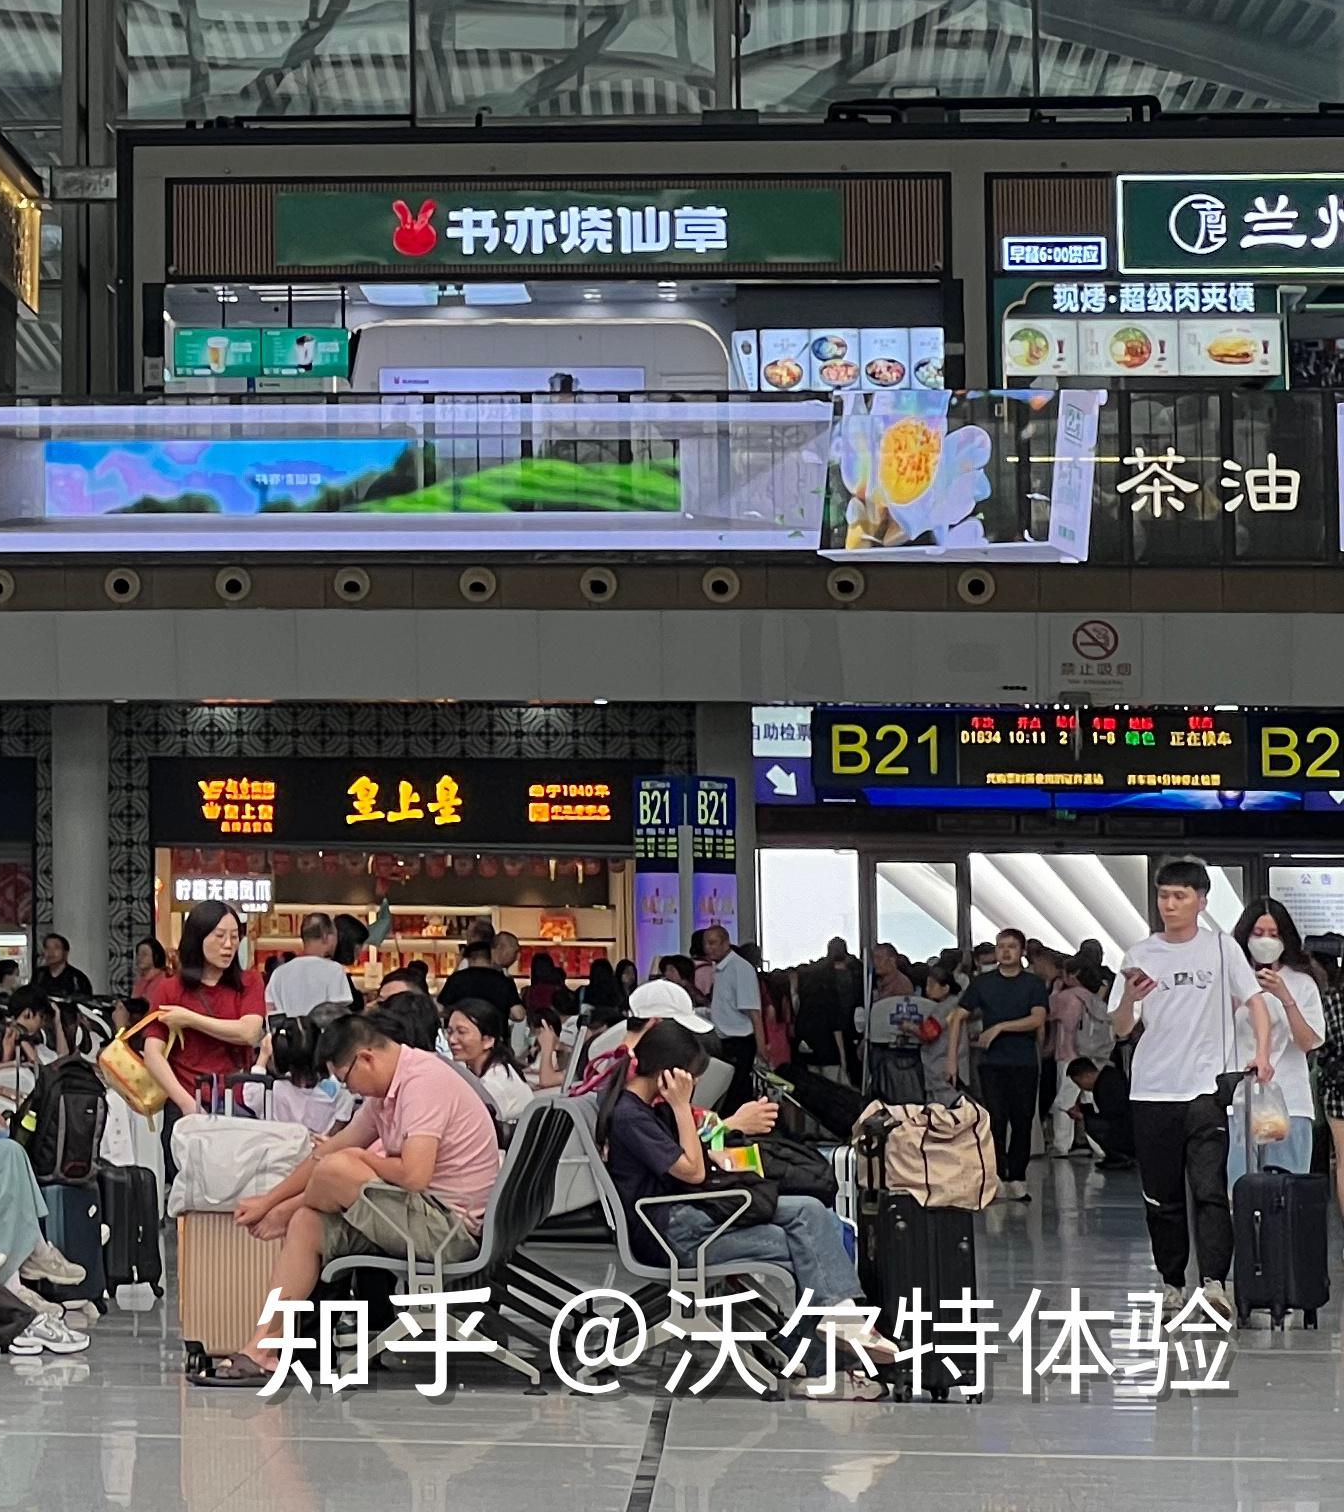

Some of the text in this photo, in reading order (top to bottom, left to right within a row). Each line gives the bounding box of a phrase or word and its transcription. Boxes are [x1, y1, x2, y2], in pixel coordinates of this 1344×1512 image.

[446, 206, 728, 255] 书亦烧仙草
[1009, 244, 1099, 264] 早餐6:00供应
[1116, 447, 1302, 518] 茶油
[831, 724, 939, 775] B21
[1009, 731, 1046, 744] 10:11
[1092, 731, 1116, 744] 1-8
[1170, 731, 1233, 746] 正在候车
[346, 774, 463, 826] 皇上皇
[639, 789, 670, 825] B21
[697, 790, 727, 826] B21
